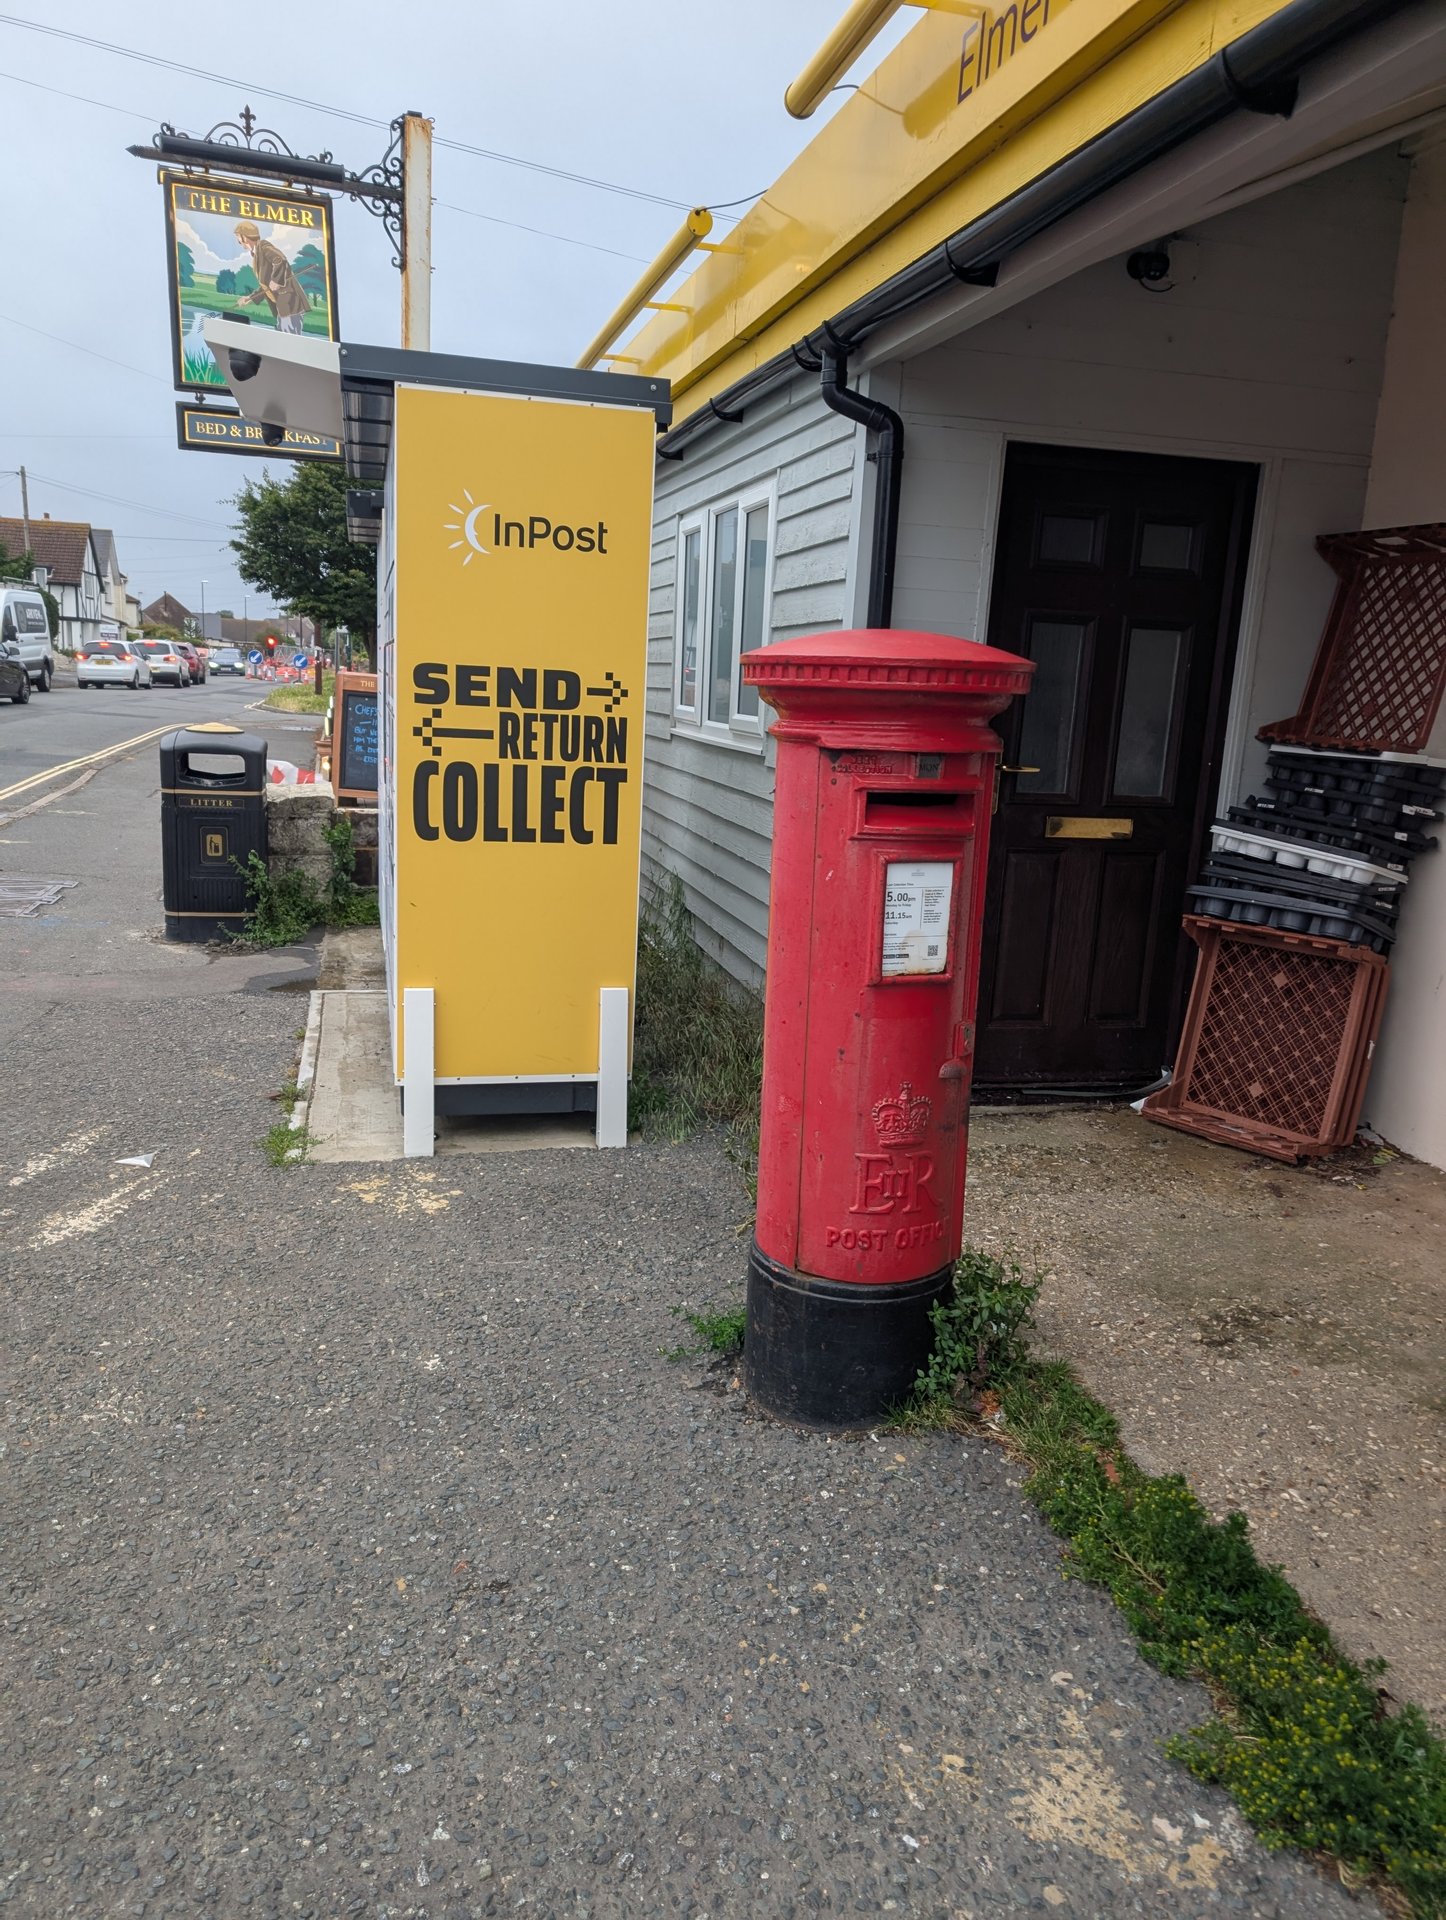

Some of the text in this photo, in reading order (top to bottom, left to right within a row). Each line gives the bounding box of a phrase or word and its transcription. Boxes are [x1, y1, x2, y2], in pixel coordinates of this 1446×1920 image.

[188, 192, 314, 227] THE ELMER
[195, 421, 227, 436] BED
[229, 425, 241, 438] &
[494, 513, 608, 554] InPost
[360, 679, 375, 688] THE
[412, 662, 582, 710] SEND
[498, 711, 628, 763] RETURN
[190, 798, 233, 807] LITTER
[412, 760, 628, 845] COLLECT
[886, 891, 916, 902] 5.00pm
[826, 1226, 888, 1252] POST
